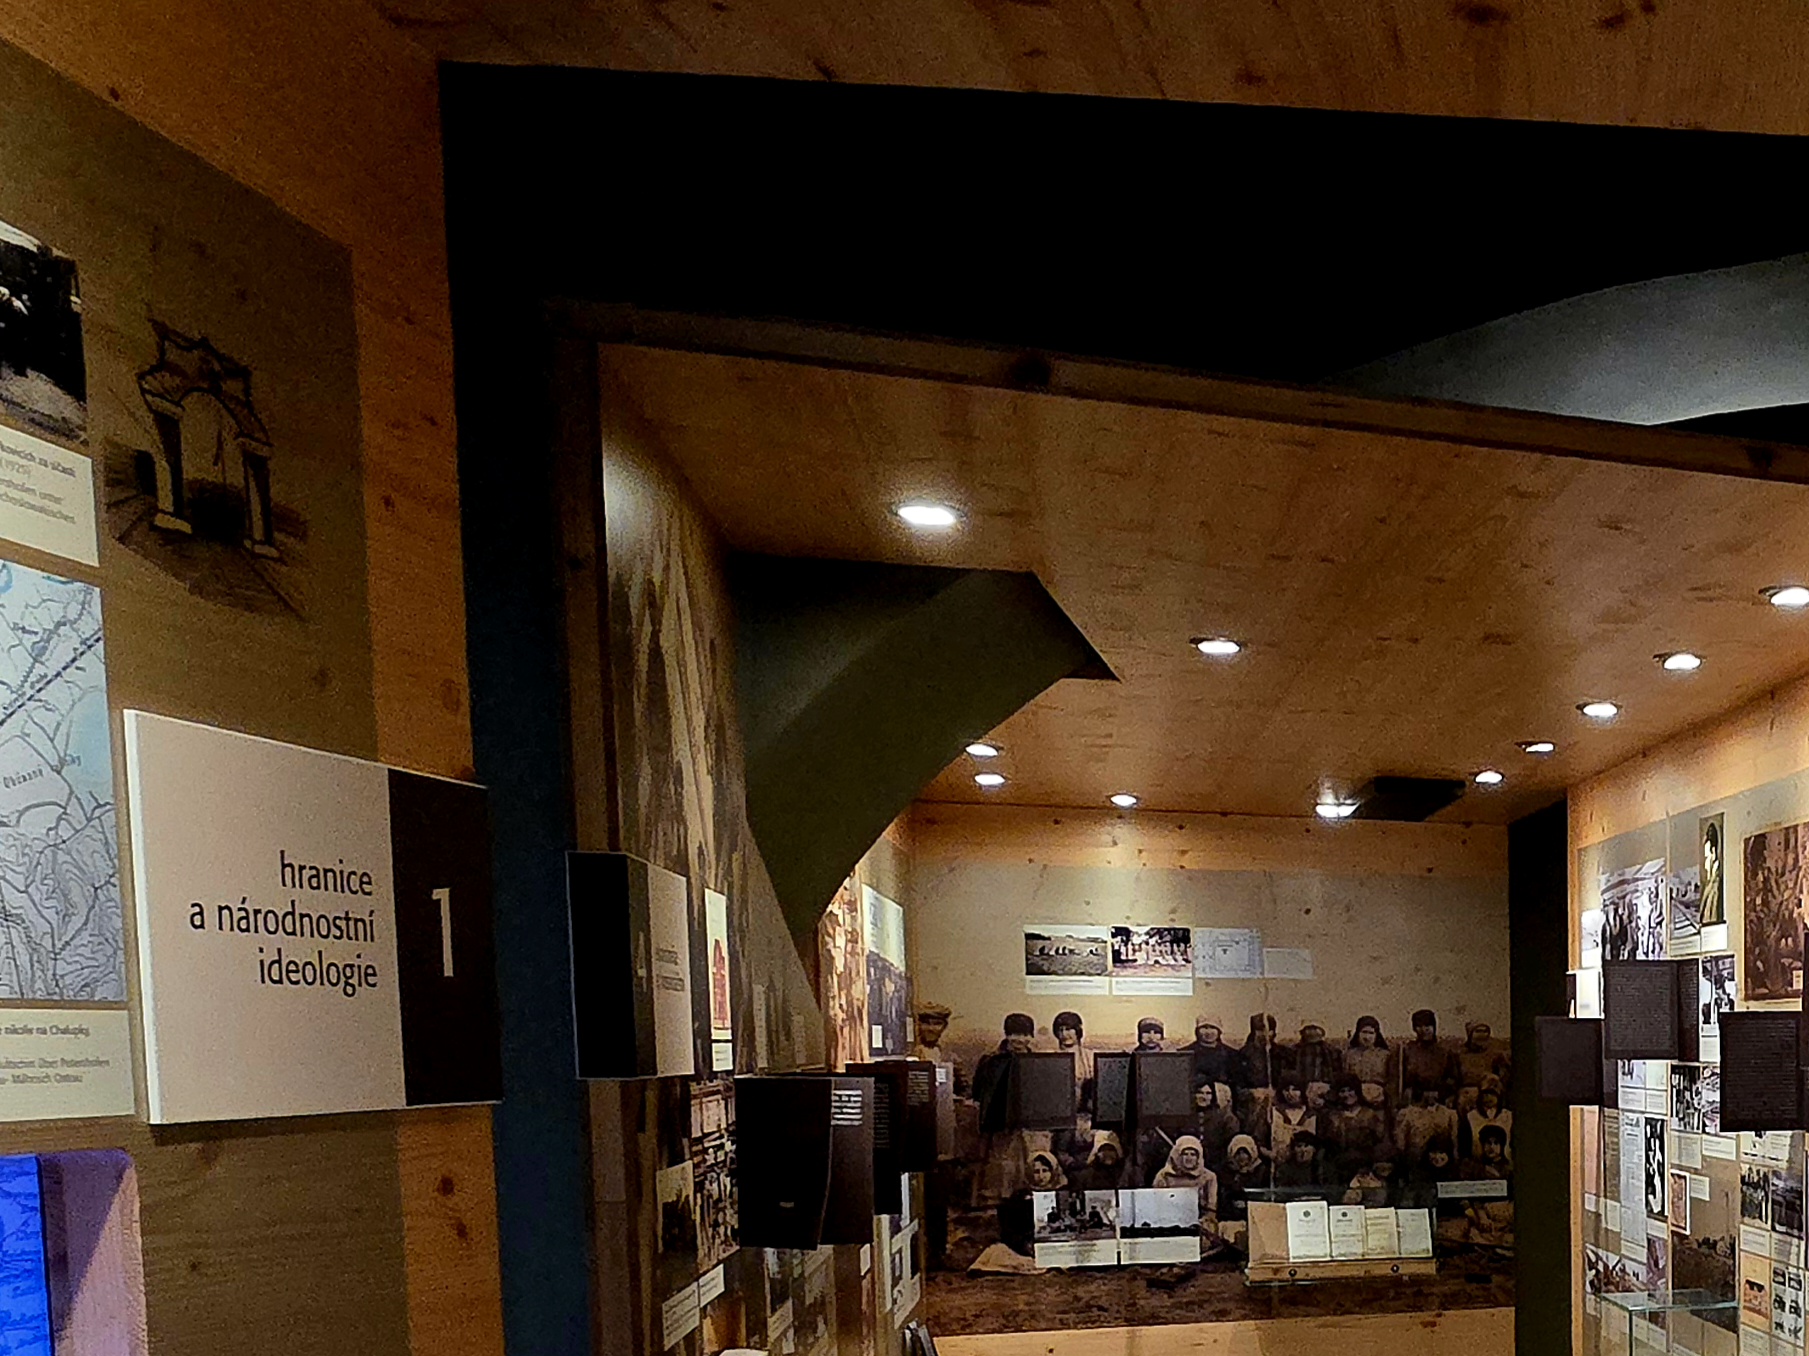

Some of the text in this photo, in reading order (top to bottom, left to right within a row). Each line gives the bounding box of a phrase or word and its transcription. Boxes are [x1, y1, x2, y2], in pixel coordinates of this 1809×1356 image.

[280, 850, 373, 896] hranice
[190, 896, 376, 943] a národnostní
[431, 887, 454, 978] 1
[259, 948, 378, 997] ideologie
